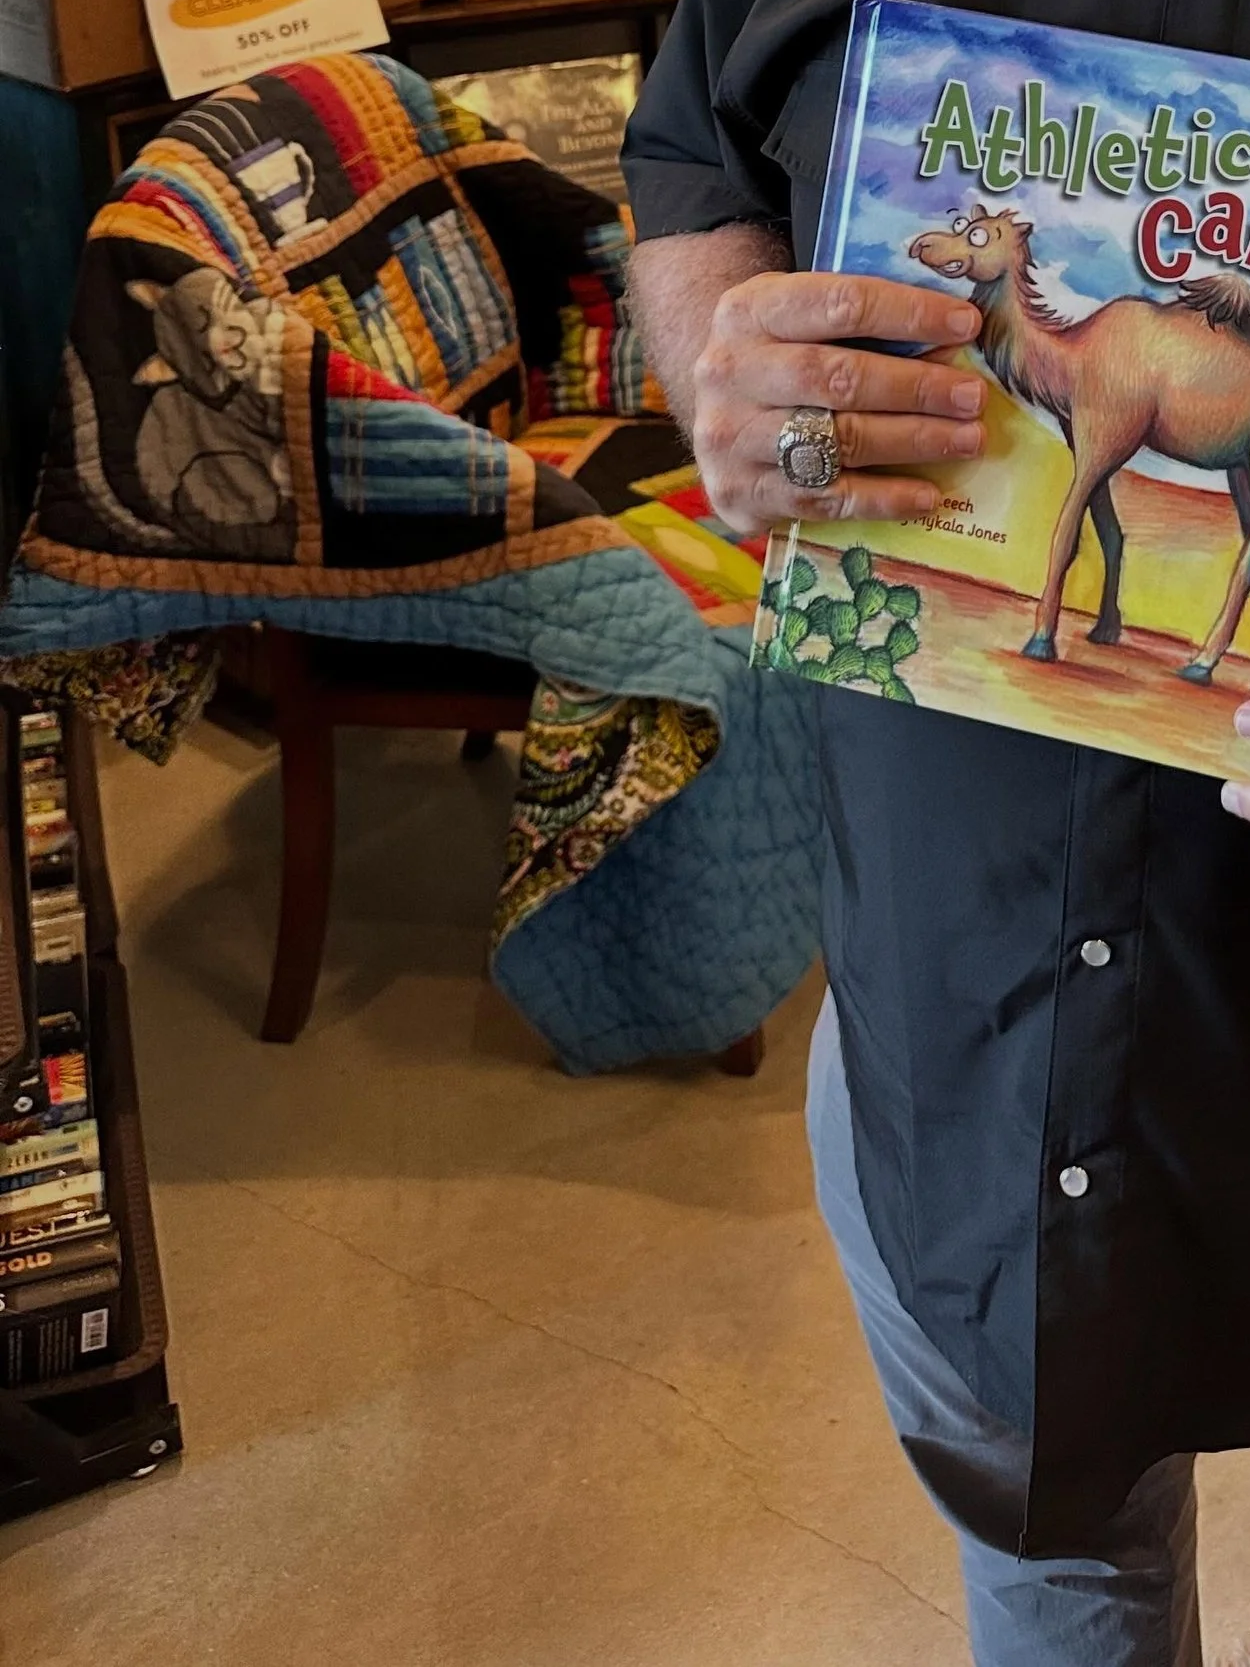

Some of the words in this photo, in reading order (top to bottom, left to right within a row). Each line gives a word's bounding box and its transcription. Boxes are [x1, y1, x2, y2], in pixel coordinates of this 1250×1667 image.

[237, 28, 274, 50] 50%
[280, 19, 310, 38] OFF
[938, 497, 975, 514] eech
[914, 515, 964, 534] Mykala
[967, 523, 1008, 544] Jones
